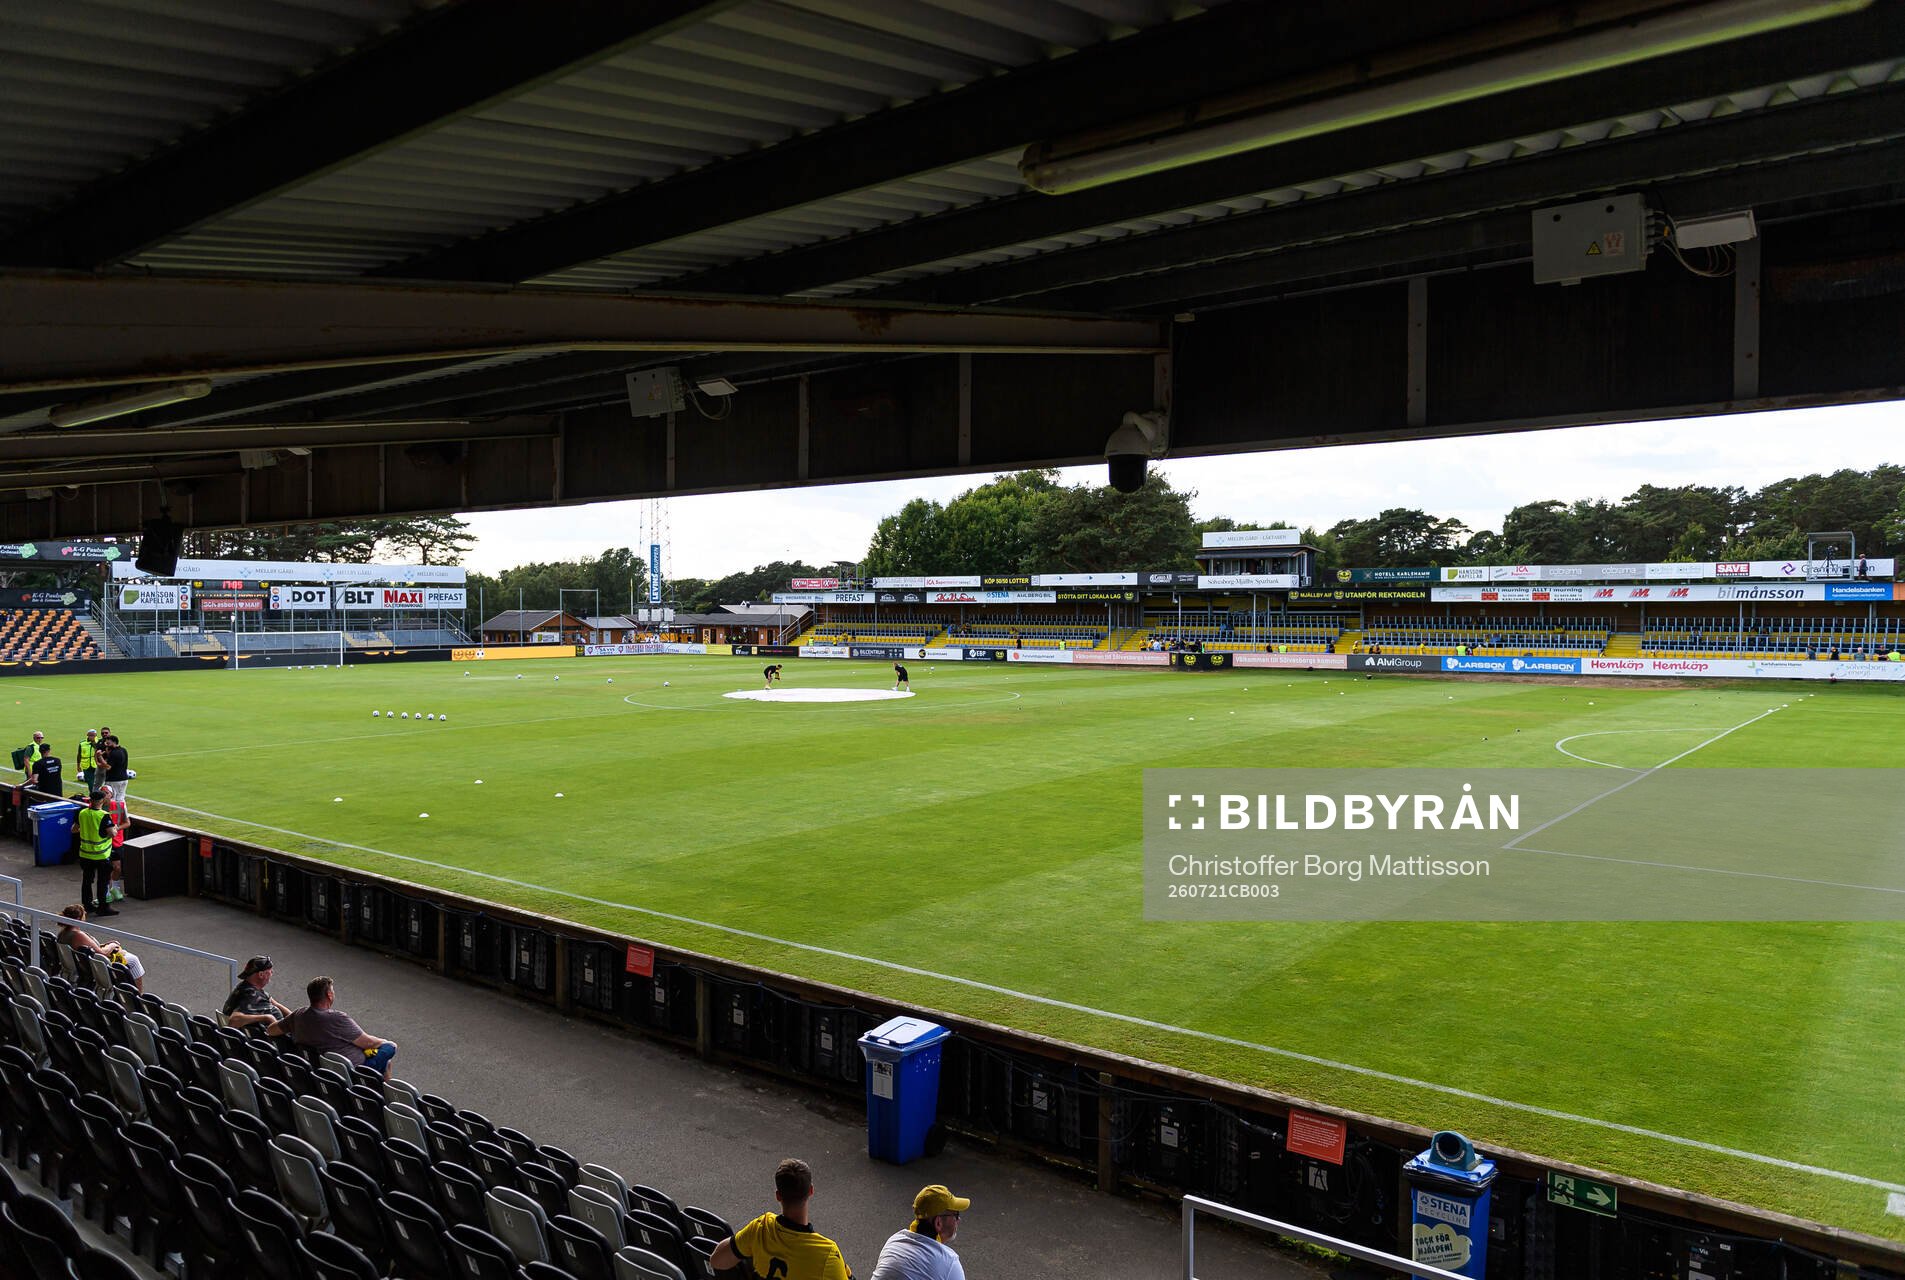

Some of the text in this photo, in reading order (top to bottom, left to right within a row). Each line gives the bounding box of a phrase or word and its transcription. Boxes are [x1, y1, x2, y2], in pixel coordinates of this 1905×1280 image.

[1717, 564, 1748, 573] SAVE
[222, 580, 244, 590] 17:05
[984, 577, 995, 585] KÖP
[1255, 577, 1279, 585] Sparbank
[428, 592, 463, 601] PREFAST
[991, 591, 1010, 599] STENA
[1057, 592, 1077, 600] STÖTTA
[1077, 592, 1089, 600] DITT
[1378, 591, 1426, 599] REKTANGELN
[1717, 585, 1804, 599] bilmånsson
[344, 590, 375, 604] BLT
[835, 593, 865, 602] PREFAST
[1279, 656, 1316, 665] Sölvesborgs
[1376, 656, 1422, 668] AlviGroup
[1458, 662, 1506, 670] LARSSON
[1524, 662, 1575, 671] LARSSON
[1591, 660, 1644, 671] Hemköp
[1653, 660, 1709, 672] Hemköp
[1430, 1198, 1468, 1217] STENA
[1418, 1205, 1468, 1226] RECYCLING
[1414, 1232, 1451, 1247] TACK FÖR
[1417, 1242, 1454, 1256] HJÄLPEN!
